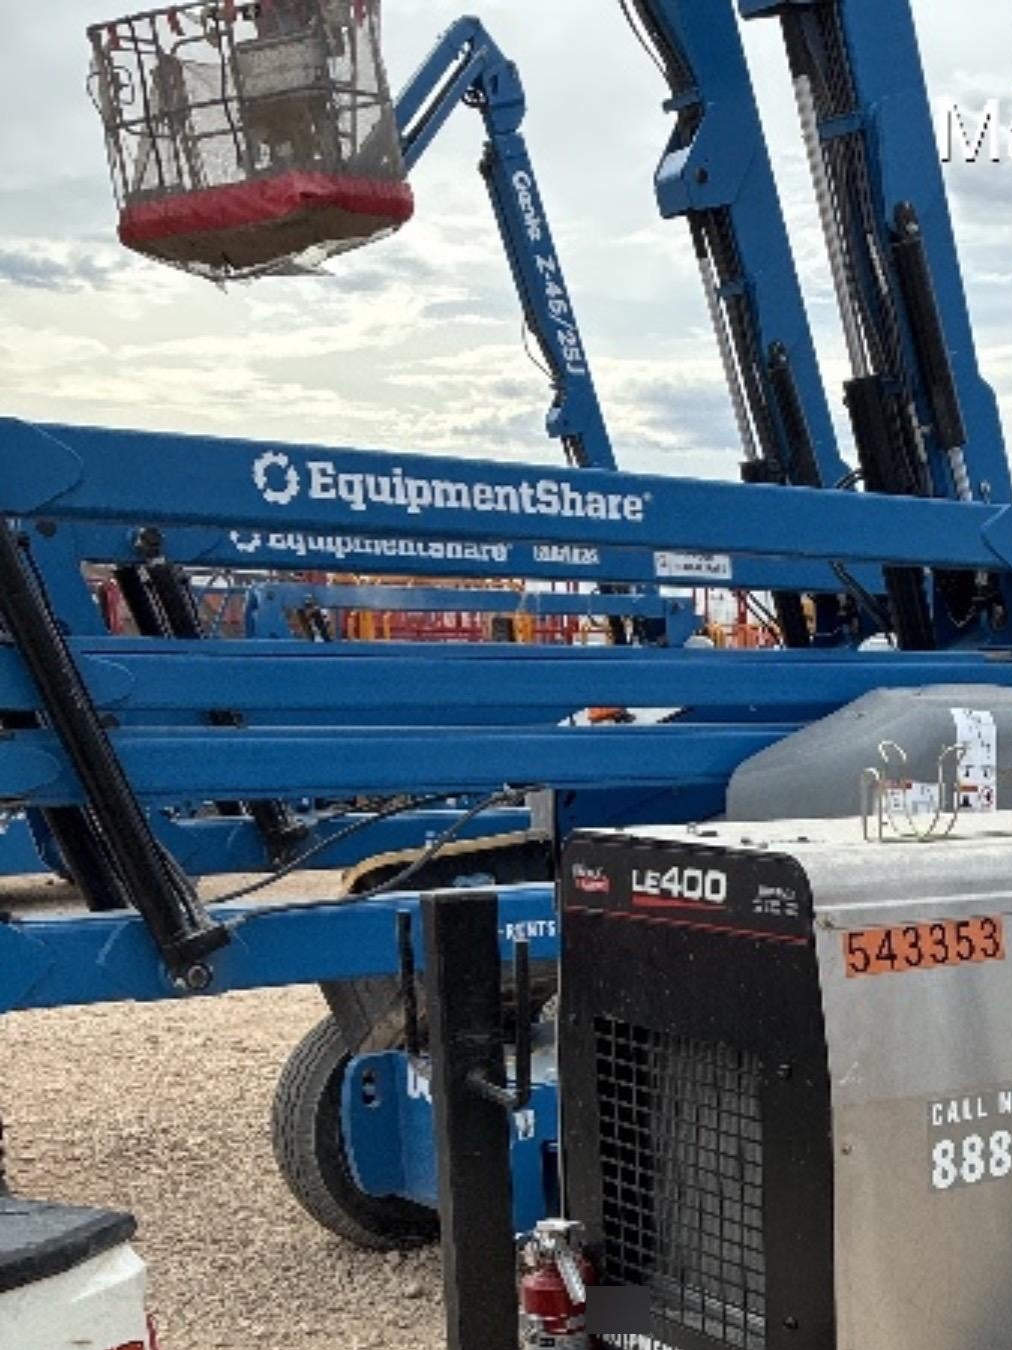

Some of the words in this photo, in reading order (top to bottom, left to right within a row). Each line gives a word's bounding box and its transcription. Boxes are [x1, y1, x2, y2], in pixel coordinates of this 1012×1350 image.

[307, 461, 645, 521] EquipmentShare
[631, 866, 728, 904] LE400
[847, 917, 1001, 973] 543353
[931, 1096, 988, 1126] CALL
